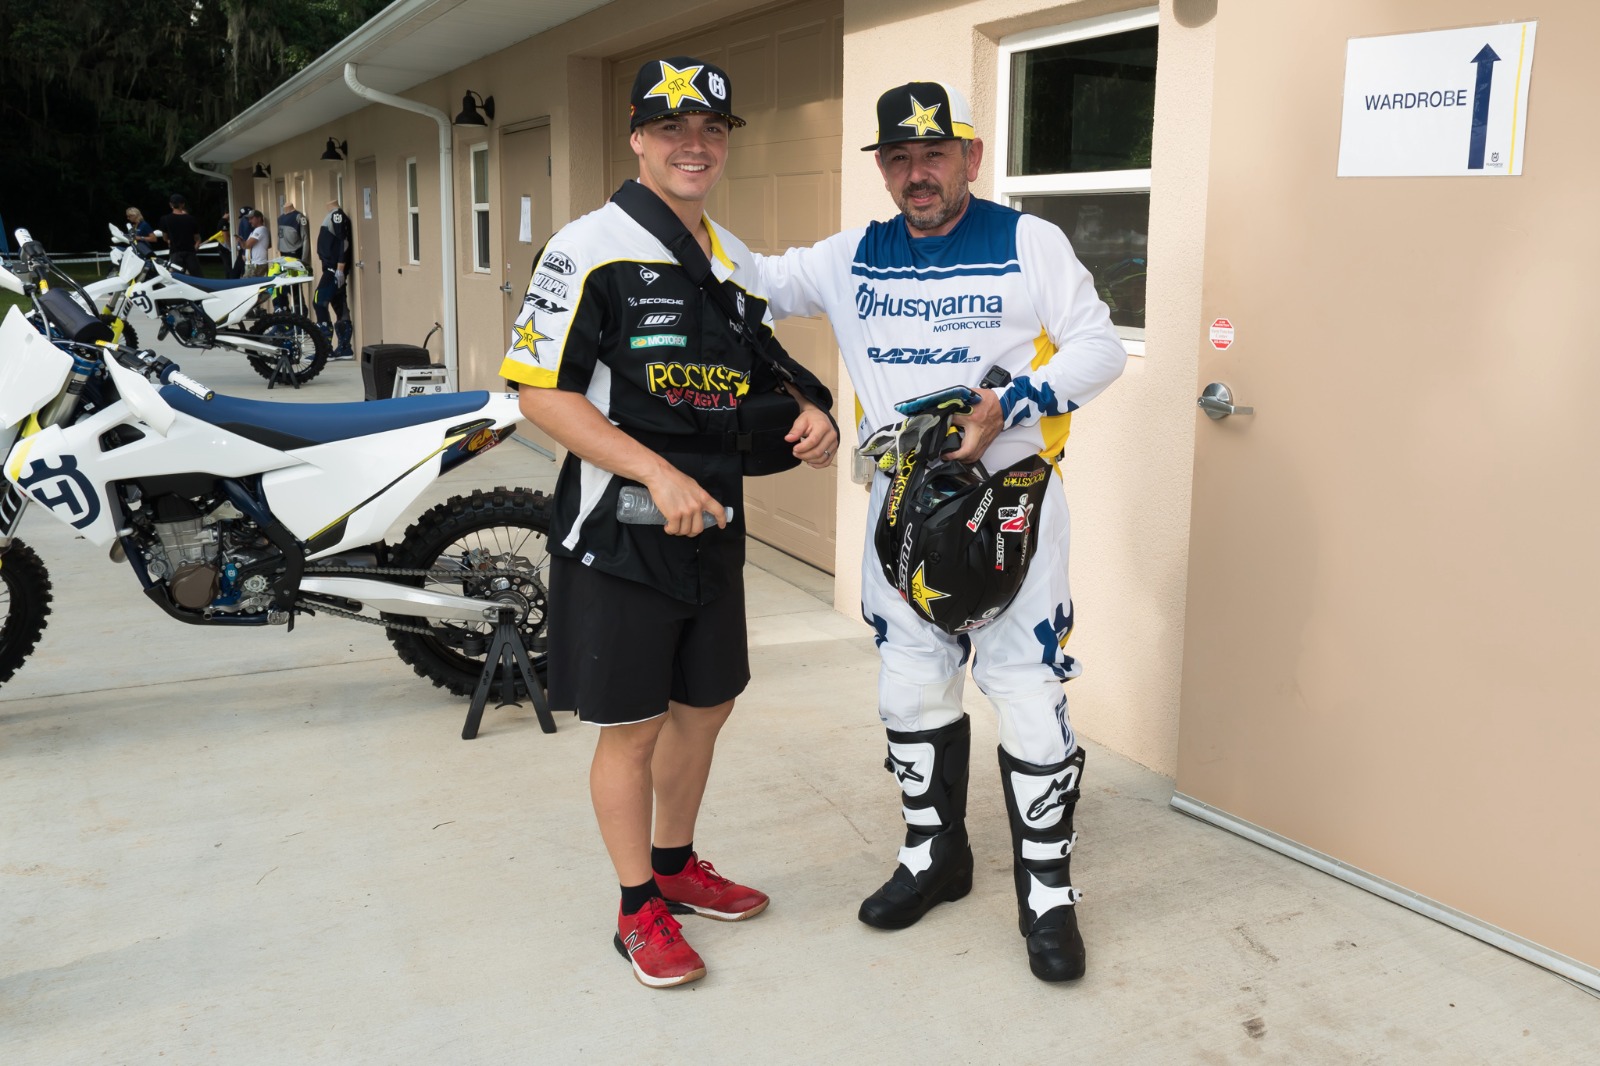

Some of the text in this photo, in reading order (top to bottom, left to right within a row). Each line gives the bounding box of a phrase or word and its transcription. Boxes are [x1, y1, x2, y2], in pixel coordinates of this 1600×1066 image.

[1364, 89, 1468, 111] WARDROBE
[525, 293, 569, 313] FLY
[639, 297, 684, 306] SCOSCHE
[872, 294, 1003, 321] Husqvarna
[933, 320, 1001, 333] MOTORCYCLES
[647, 335, 685, 346] MOTOREX
[867, 346, 970, 365] RADIKAL
[665, 387, 721, 408] ENERGY
